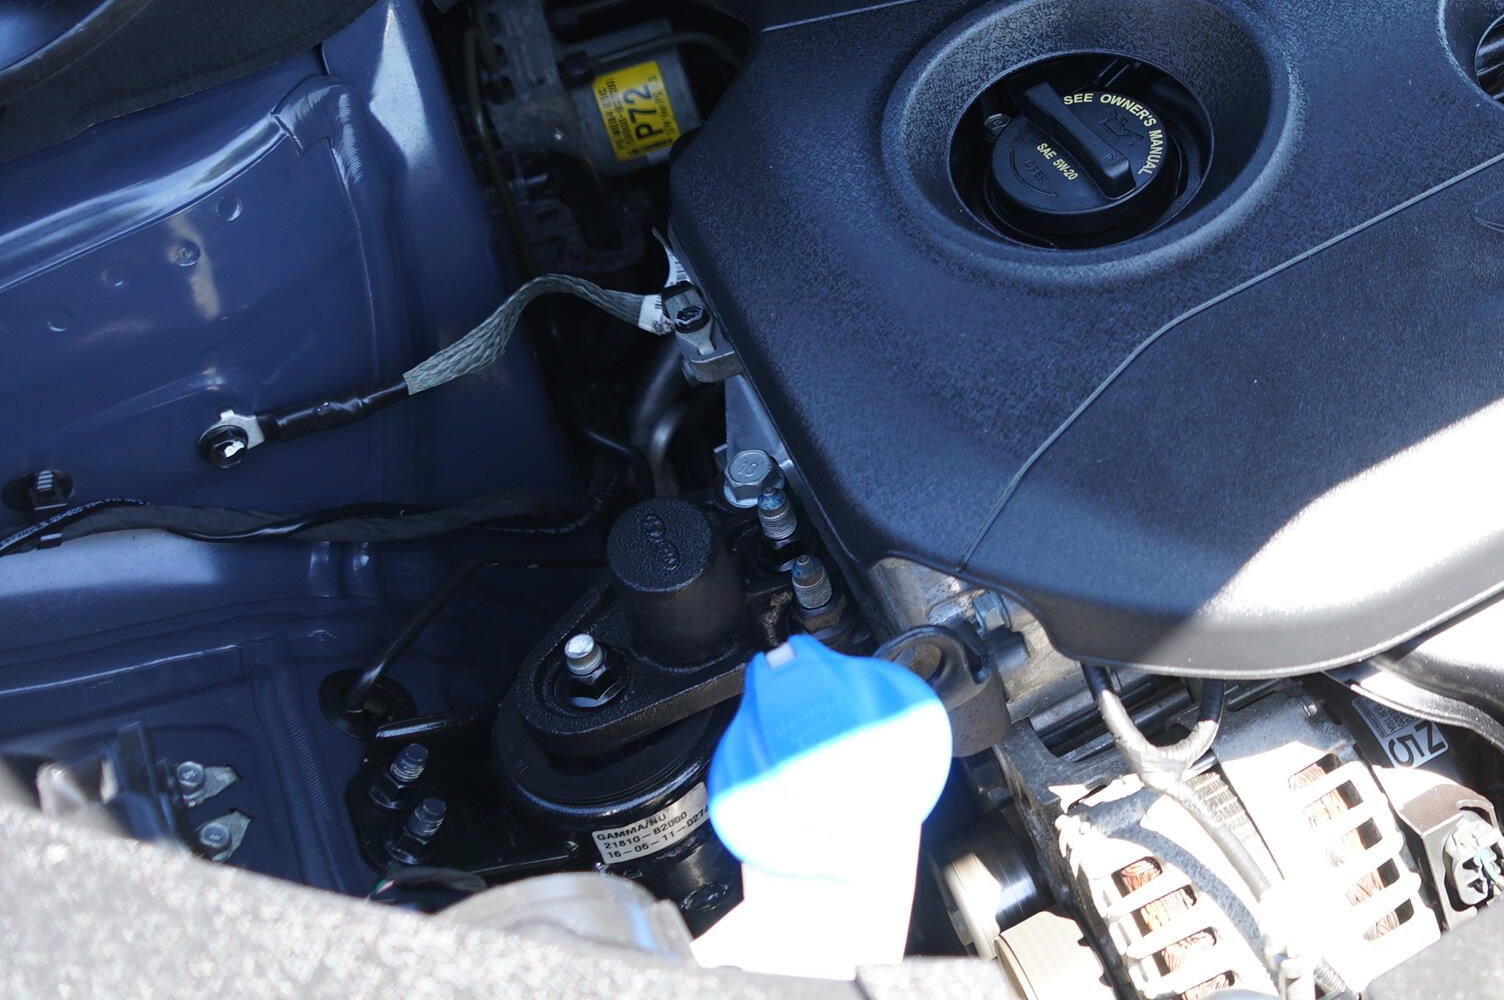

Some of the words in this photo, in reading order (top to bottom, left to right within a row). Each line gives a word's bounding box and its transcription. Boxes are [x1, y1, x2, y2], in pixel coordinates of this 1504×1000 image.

[623, 84, 663, 139] P72
[1064, 93, 1094, 105] SEE
[1100, 93, 1157, 127] OWNER'S
[1137, 129, 1164, 175] MANUAL
[1036, 143, 1056, 160] SAE
[1053, 158, 1078, 181] 5W-20
[597, 813, 666, 840] GAMMA/NU
